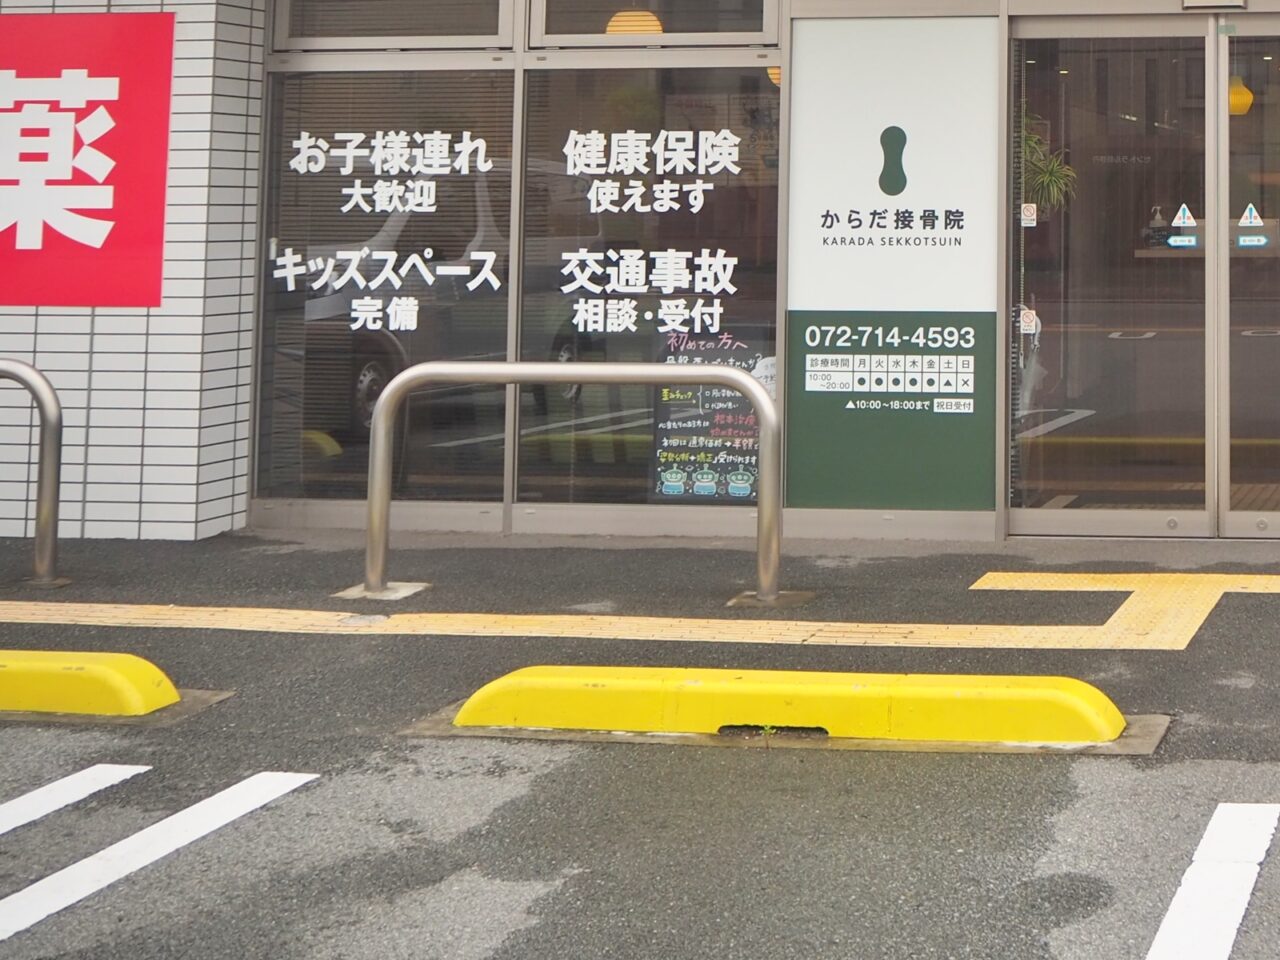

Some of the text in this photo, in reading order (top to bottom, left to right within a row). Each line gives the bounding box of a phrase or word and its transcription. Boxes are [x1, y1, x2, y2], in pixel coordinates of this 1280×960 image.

[0, 68, 120, 250] 薬
[289, 130, 494, 176] お子様連れ
[562, 129, 742, 176] 健康保険
[340, 179, 437, 213] 大歓迎
[586, 179, 714, 214] 使えます
[821, 208, 964, 230] からだ接骨院
[823, 237, 962, 246] KARADA SEKKOTSUIN
[273, 246, 501, 291] キッズスペース
[560, 248, 738, 295] 交通事故
[350, 296, 419, 331] 完備
[572, 298, 724, 333] 相談・受付
[805, 325, 975, 348] 072-714-4593
[809, 357, 970, 369] 診療時間 月 火 水 木 金 土 日
[809, 373, 832, 381] 10:00
[936, 399, 972, 411] 祝日受付
